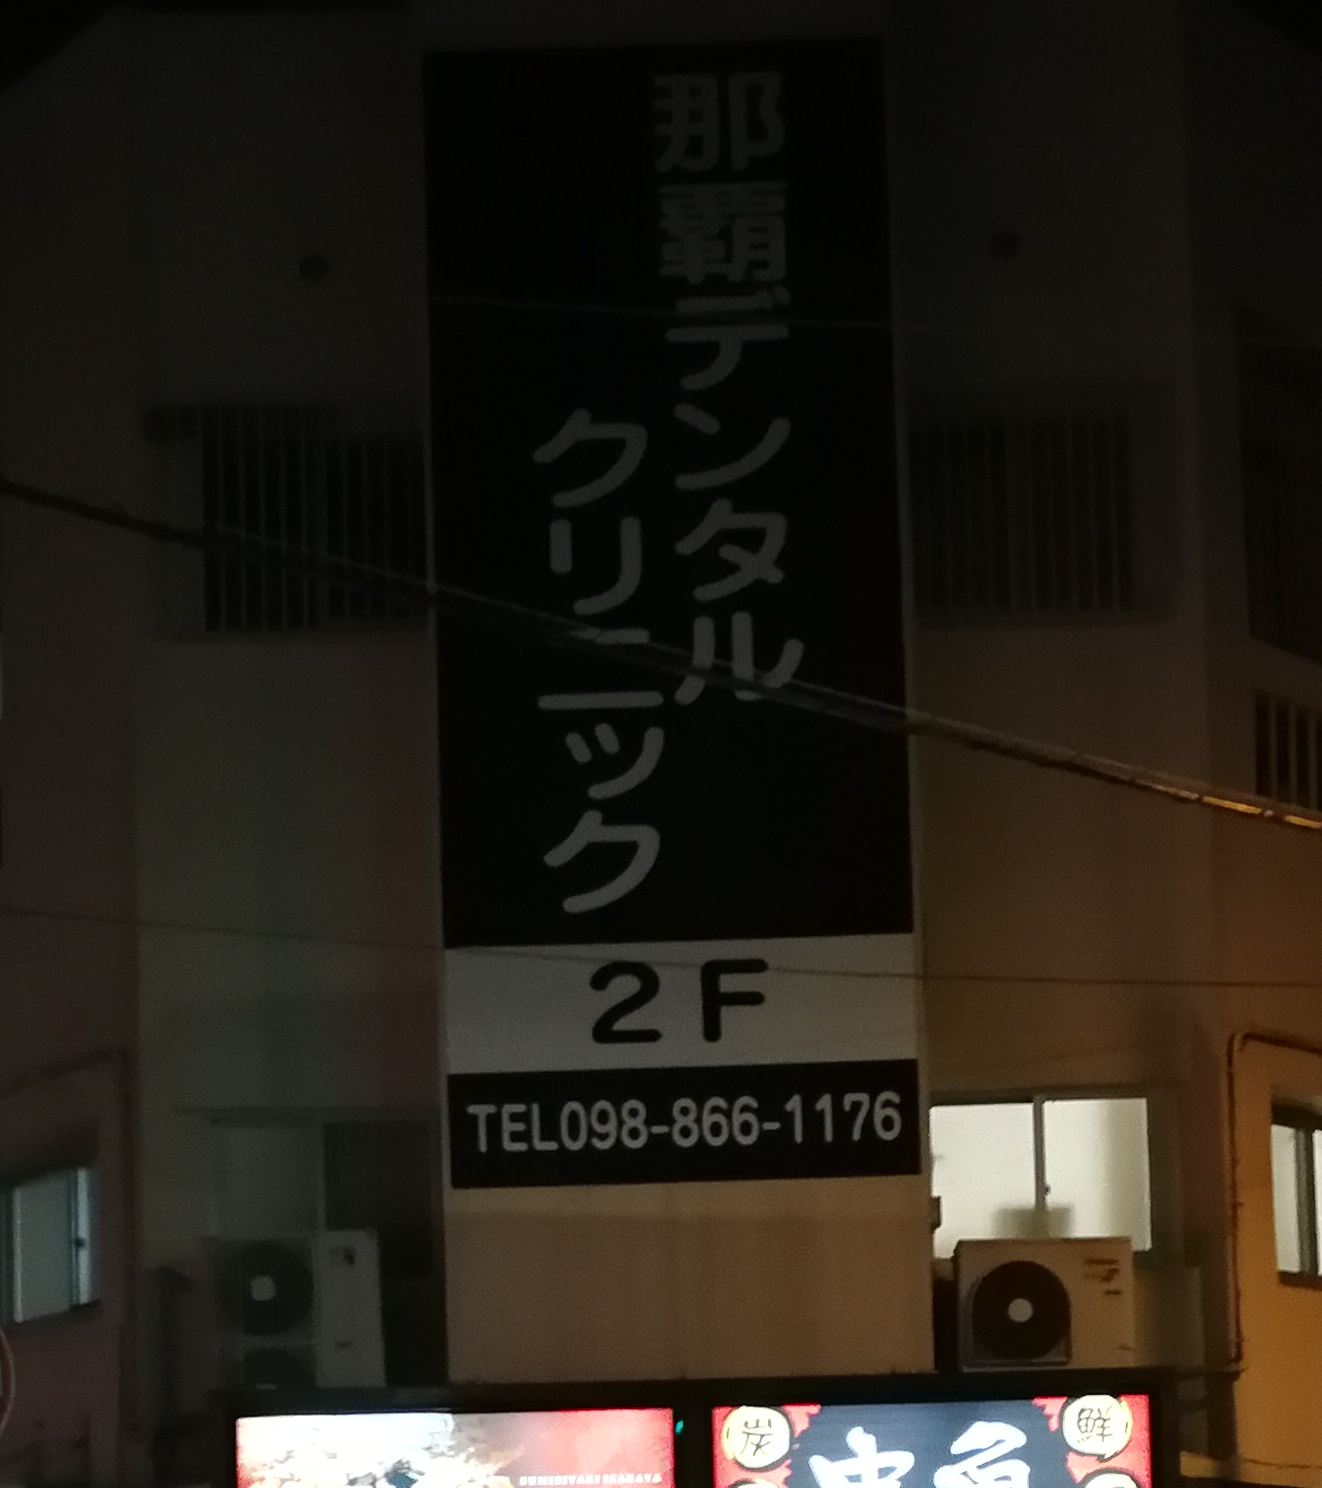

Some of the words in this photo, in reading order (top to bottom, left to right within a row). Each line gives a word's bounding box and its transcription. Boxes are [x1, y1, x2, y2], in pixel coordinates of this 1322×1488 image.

[653, 71, 805, 705] 那覇デンタル
[533, 408, 665, 914] クリニック
[466, 1091, 903, 1153] TEL098-866-1176
[589, 958, 768, 1044] 2F
